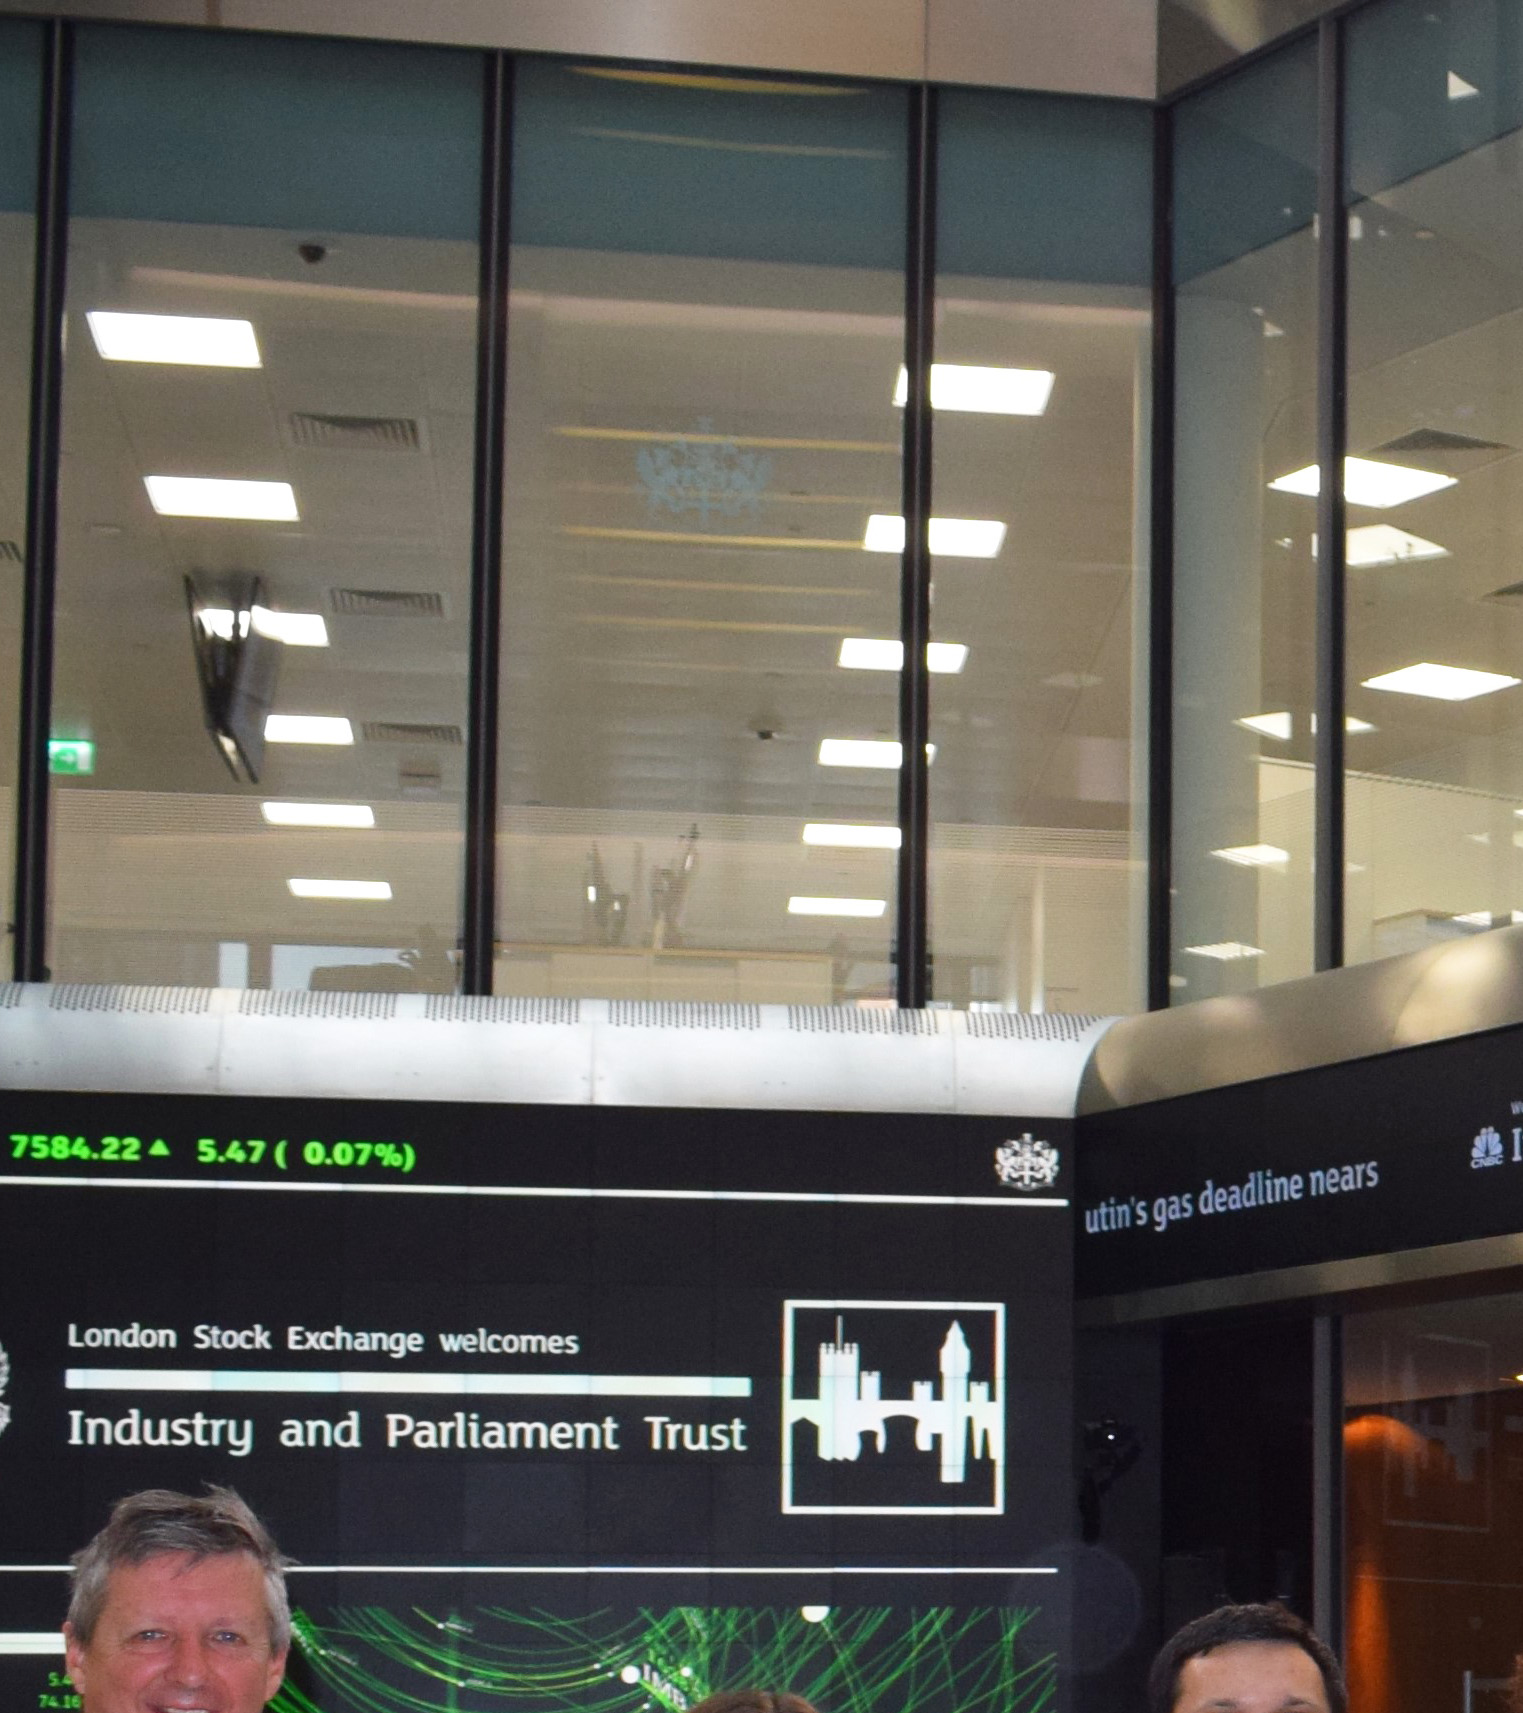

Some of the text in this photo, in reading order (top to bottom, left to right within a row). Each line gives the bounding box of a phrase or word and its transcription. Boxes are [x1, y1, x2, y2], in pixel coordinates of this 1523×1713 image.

[10, 1135, 140, 1160] 7584.22
[198, 1139, 266, 1163] 5.47
[304, 1141, 415, 1172] 0.07%)
[1153, 1194, 1193, 1231] gas
[1199, 1170, 1303, 1214] deadline
[1309, 1161, 1378, 1196] nears
[69, 1323, 579, 1358] London Stock Exchange welcomes
[69, 1409, 747, 1456] Industry and Parliament Trust
